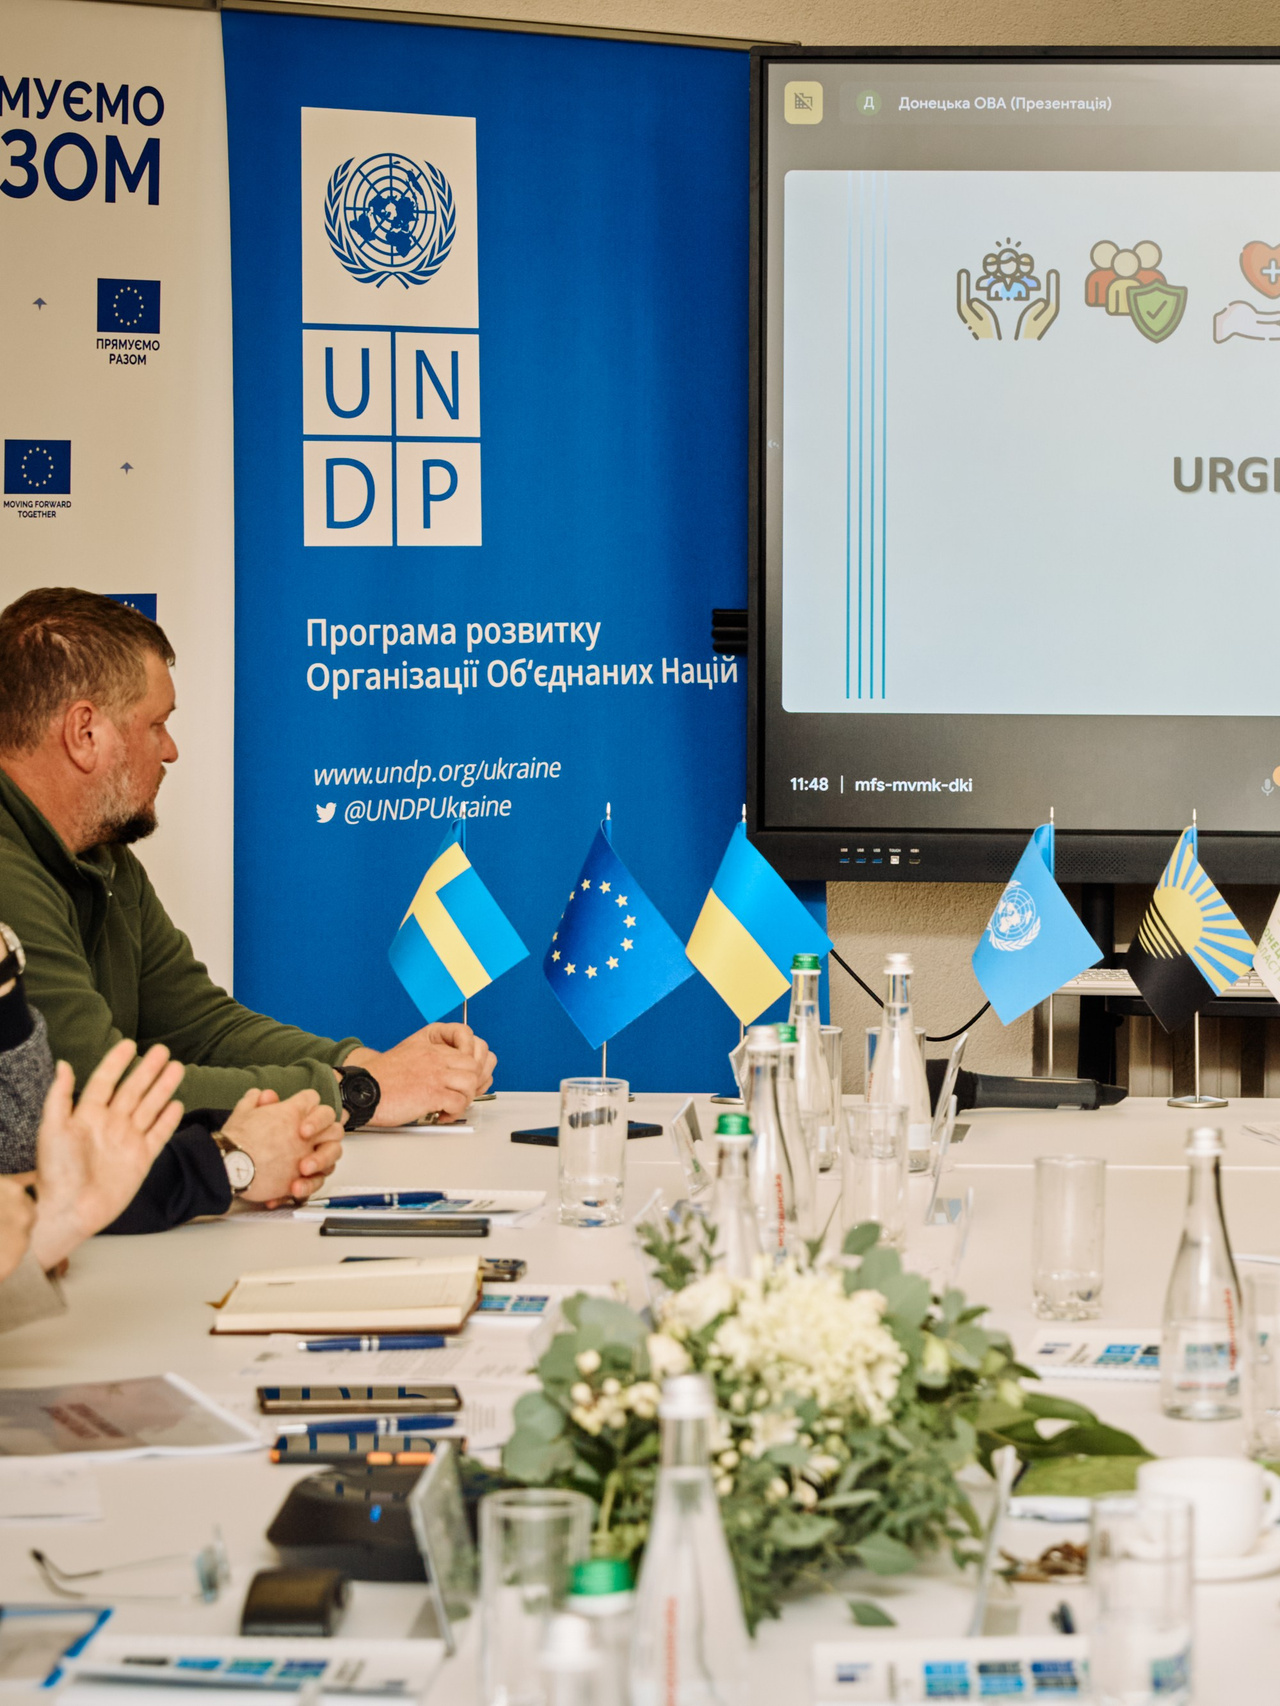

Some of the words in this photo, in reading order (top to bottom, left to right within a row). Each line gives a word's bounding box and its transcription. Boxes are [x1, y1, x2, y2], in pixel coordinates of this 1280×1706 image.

[0, 75, 165, 126] МУЄМО
[899, 96, 970, 111] Донецька
[974, 97, 1006, 110] ОВА
[1010, 96, 1112, 112] (Презентація)
[0, 128, 160, 206] ЗОМ
[96, 338, 160, 351] ПРЯМУЄМО
[109, 353, 146, 365] РАЗОМ
[3, 500, 34, 508] MOVING
[34, 500, 72, 508] FORWARD
[18, 510, 57, 518] TOGETHER
[306, 617, 458, 654] Програма
[466, 620, 602, 652] розвитку
[306, 659, 480, 699] Організації
[661, 655, 738, 690] Націй
[313, 758, 562, 788] www.undp.org/ukraine
[790, 777, 829, 791] 11:48
[855, 777, 973, 792] mfs-mvmk-dki
[343, 796, 512, 825] @UNDPUkraine
